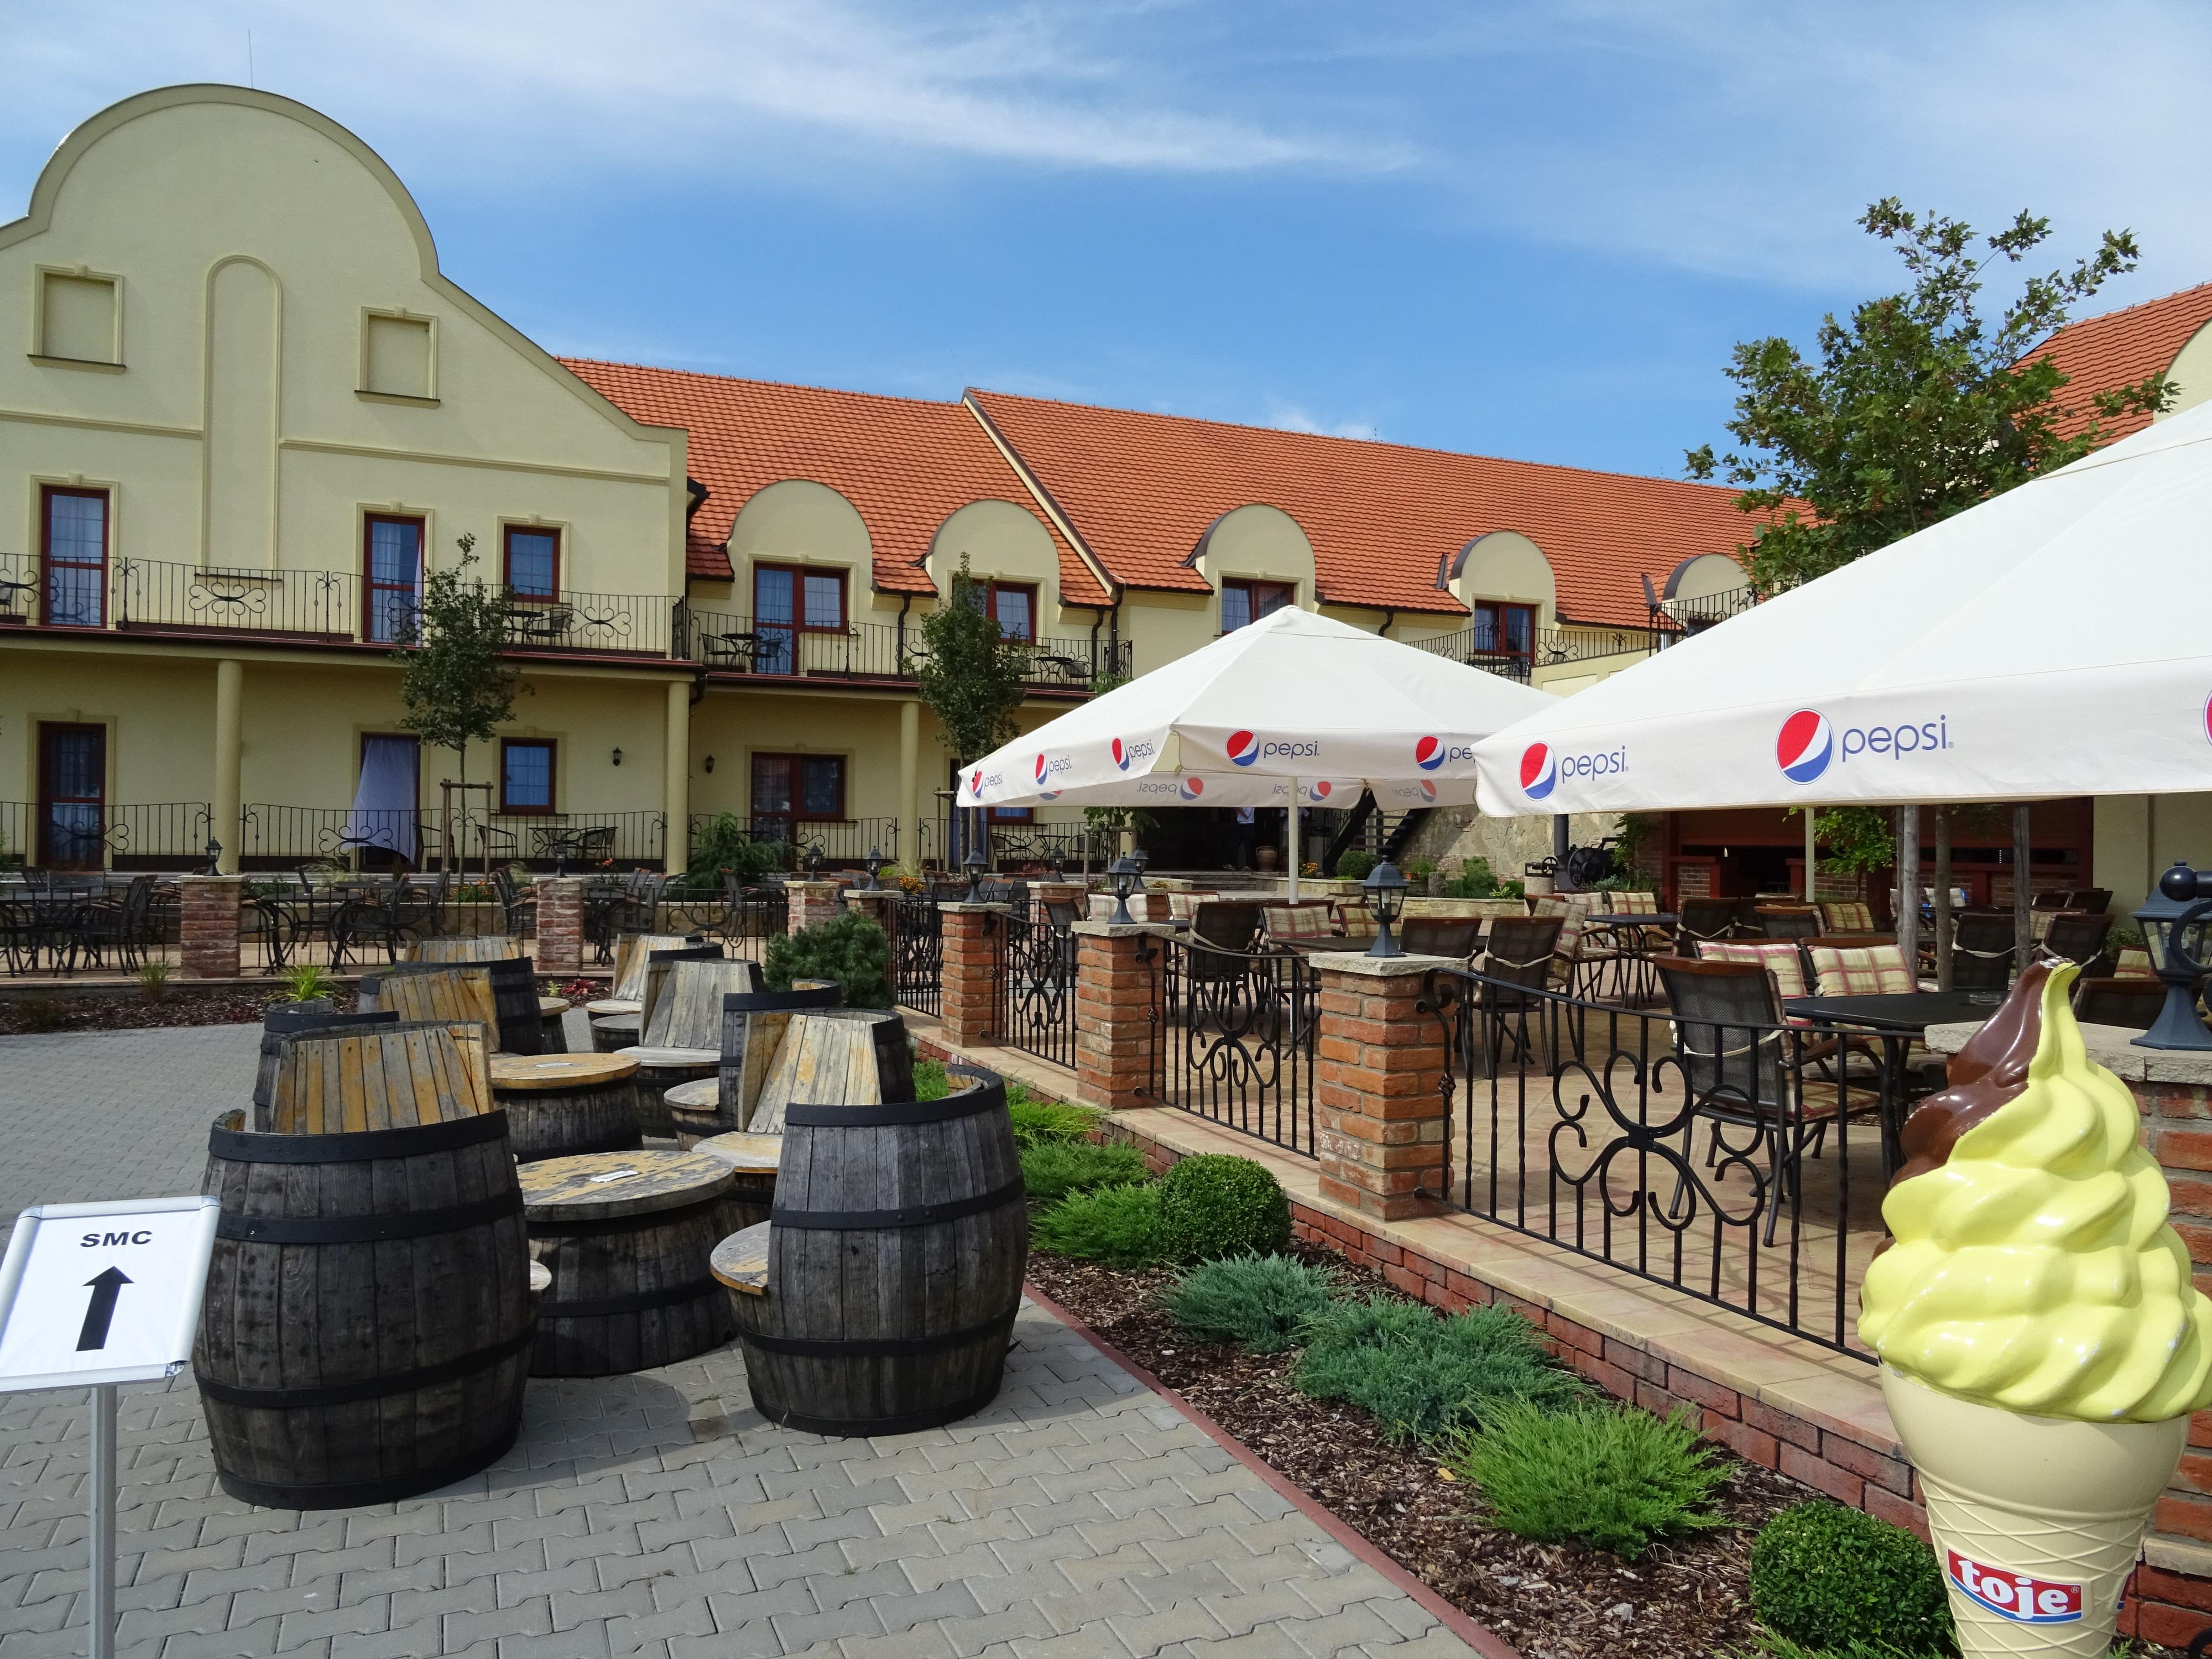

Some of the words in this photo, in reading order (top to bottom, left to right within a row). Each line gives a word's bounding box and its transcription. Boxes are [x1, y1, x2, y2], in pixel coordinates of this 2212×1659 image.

[1841, 714, 1947, 763] pepsi
[1129, 739, 1155, 761] pepsi
[1264, 740, 1318, 759] pepsi
[1048, 755, 1072, 775] pepsi
[1561, 745, 1626, 784] pepsi
[984, 771, 1003, 790] pepsi
[80, 1230, 153, 1248] SMC
[1958, 1559, 2069, 1619] toje
